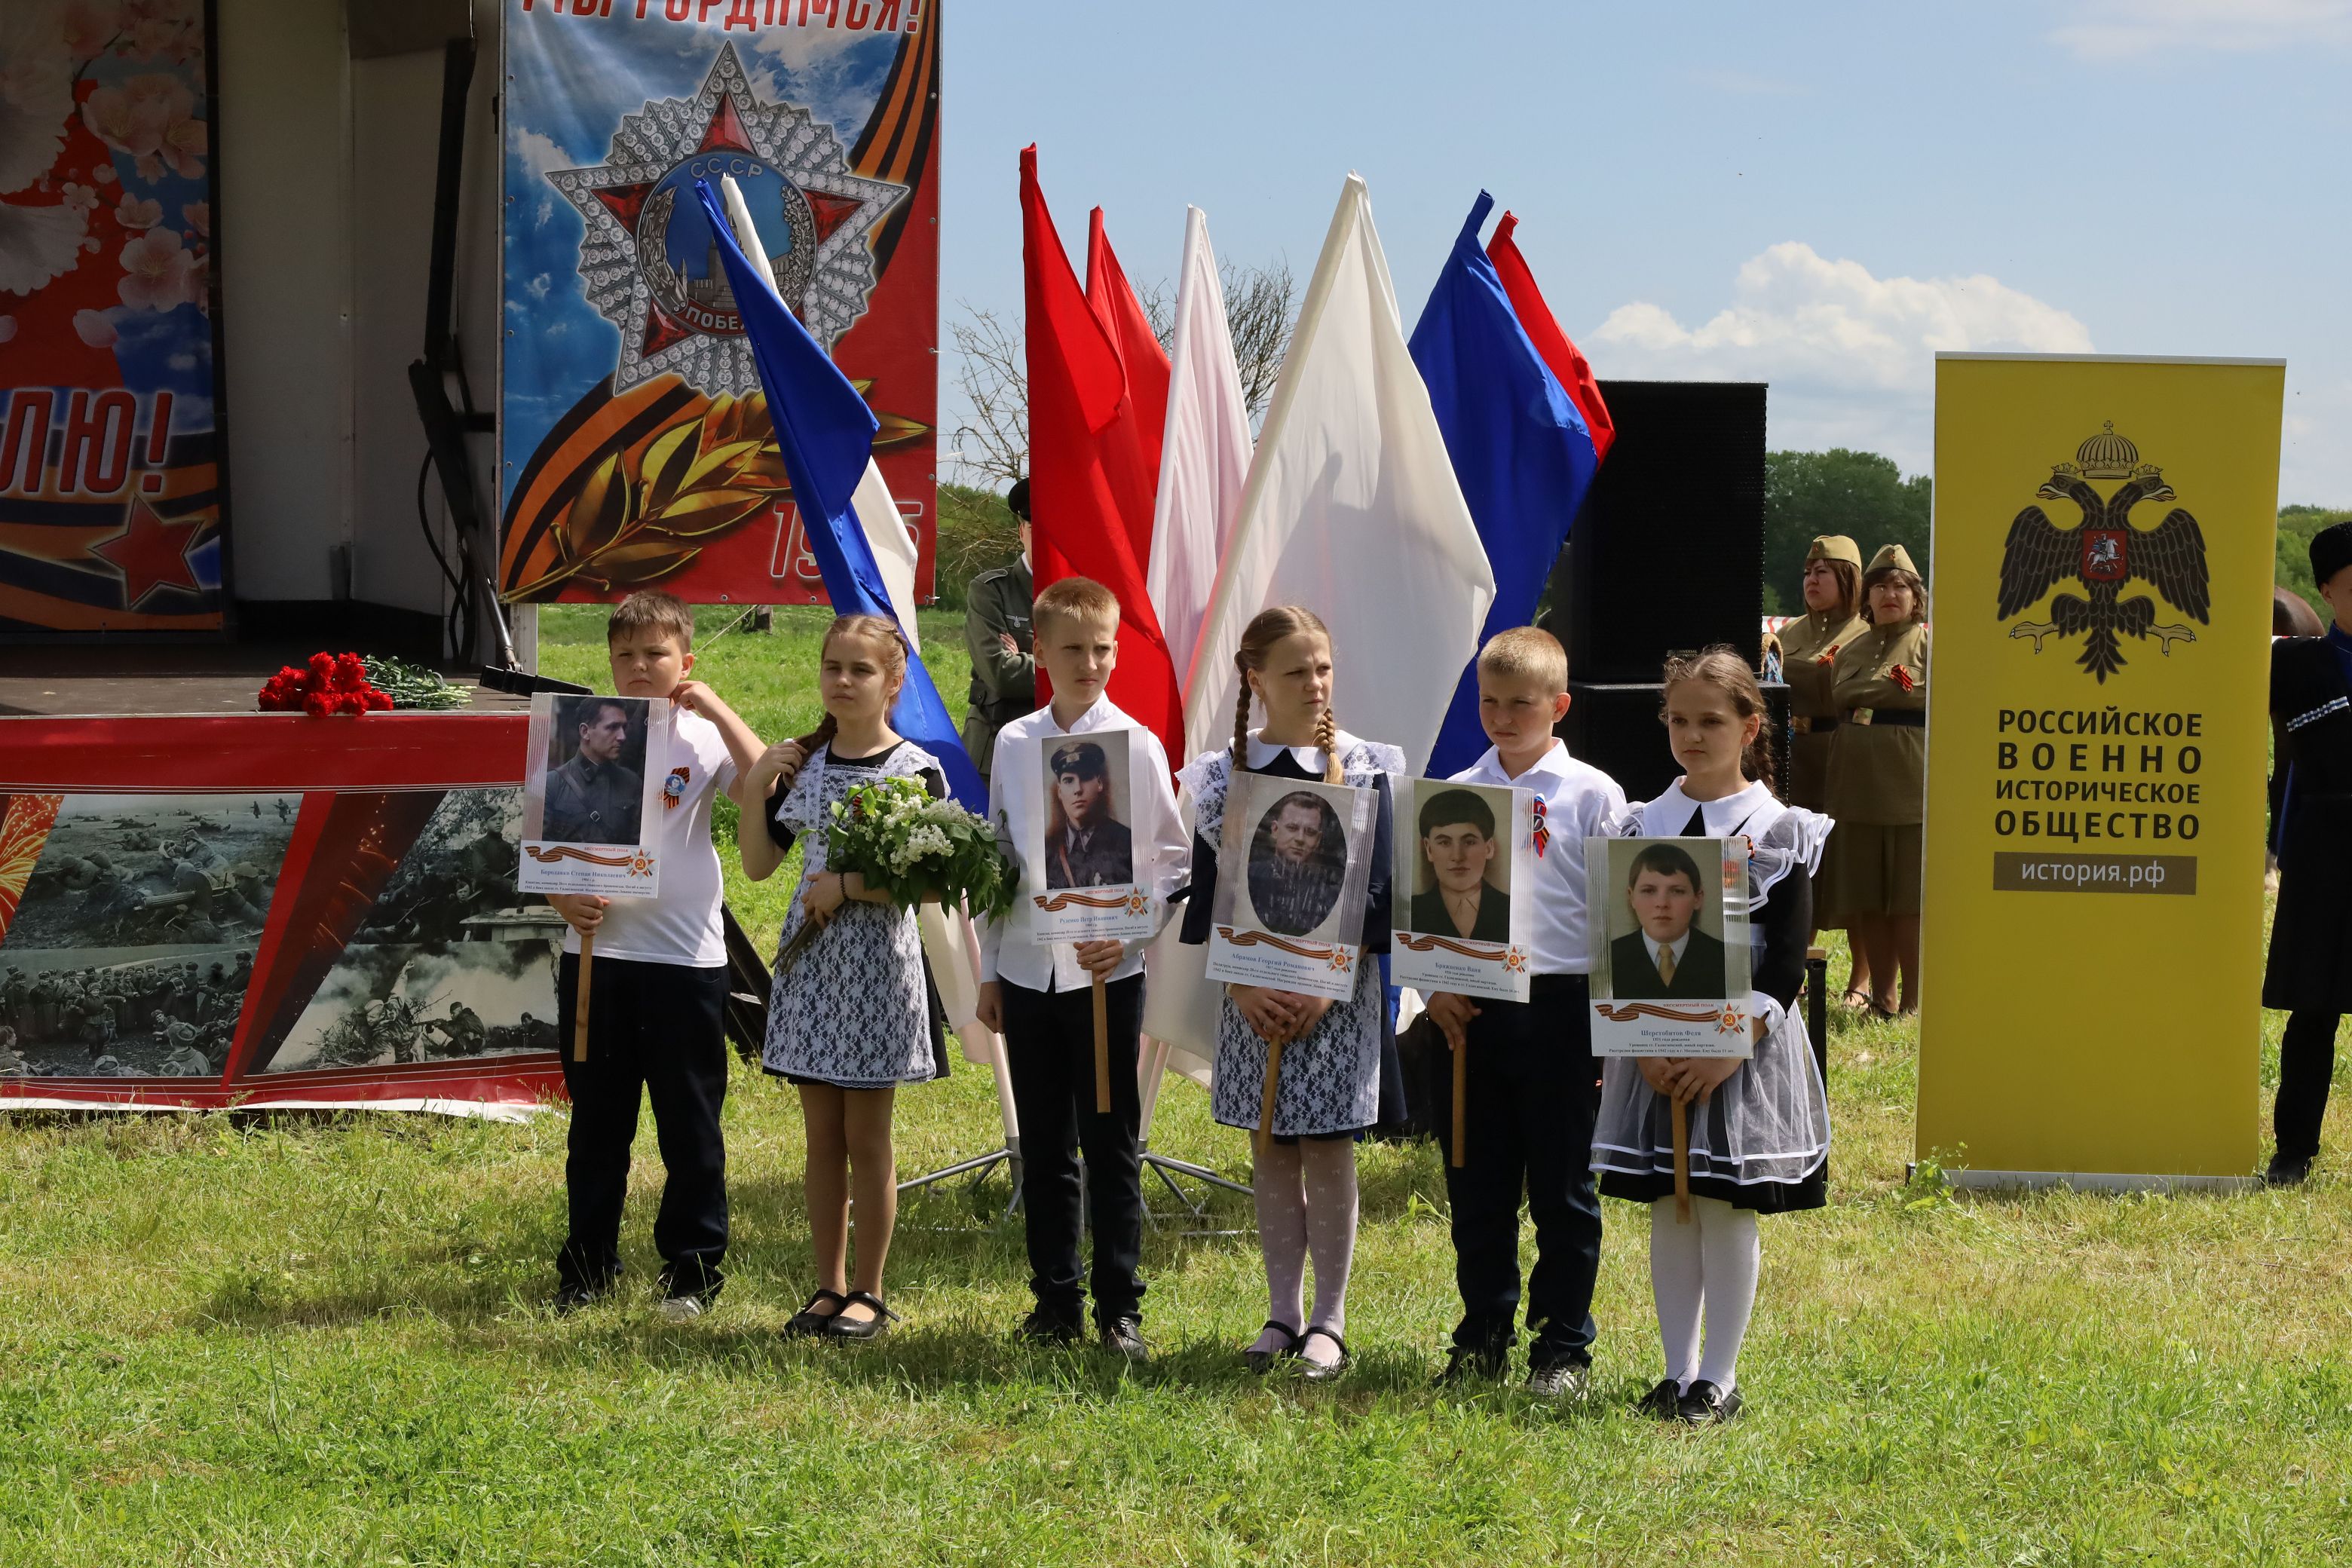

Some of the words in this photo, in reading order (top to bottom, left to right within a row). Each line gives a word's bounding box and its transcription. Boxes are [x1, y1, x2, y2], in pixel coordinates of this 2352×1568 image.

[691, 158, 763, 178] СССР
[685, 307, 744, 330] ПОБЕ
[1998, 706, 2202, 737] РОССИЙСКОЕ
[1998, 742, 2202, 774] ВОЕННО
[1995, 779, 2200, 804] ИСТОРИЧЕСКОЕ
[1995, 810, 2200, 844] ОБЩЕСТВО
[2021, 860, 2166, 888] история.рф
[1232, 953, 1257, 964] Абрамов
[1258, 956, 1282, 967] Георгий
[1283, 960, 1315, 972] Романович
